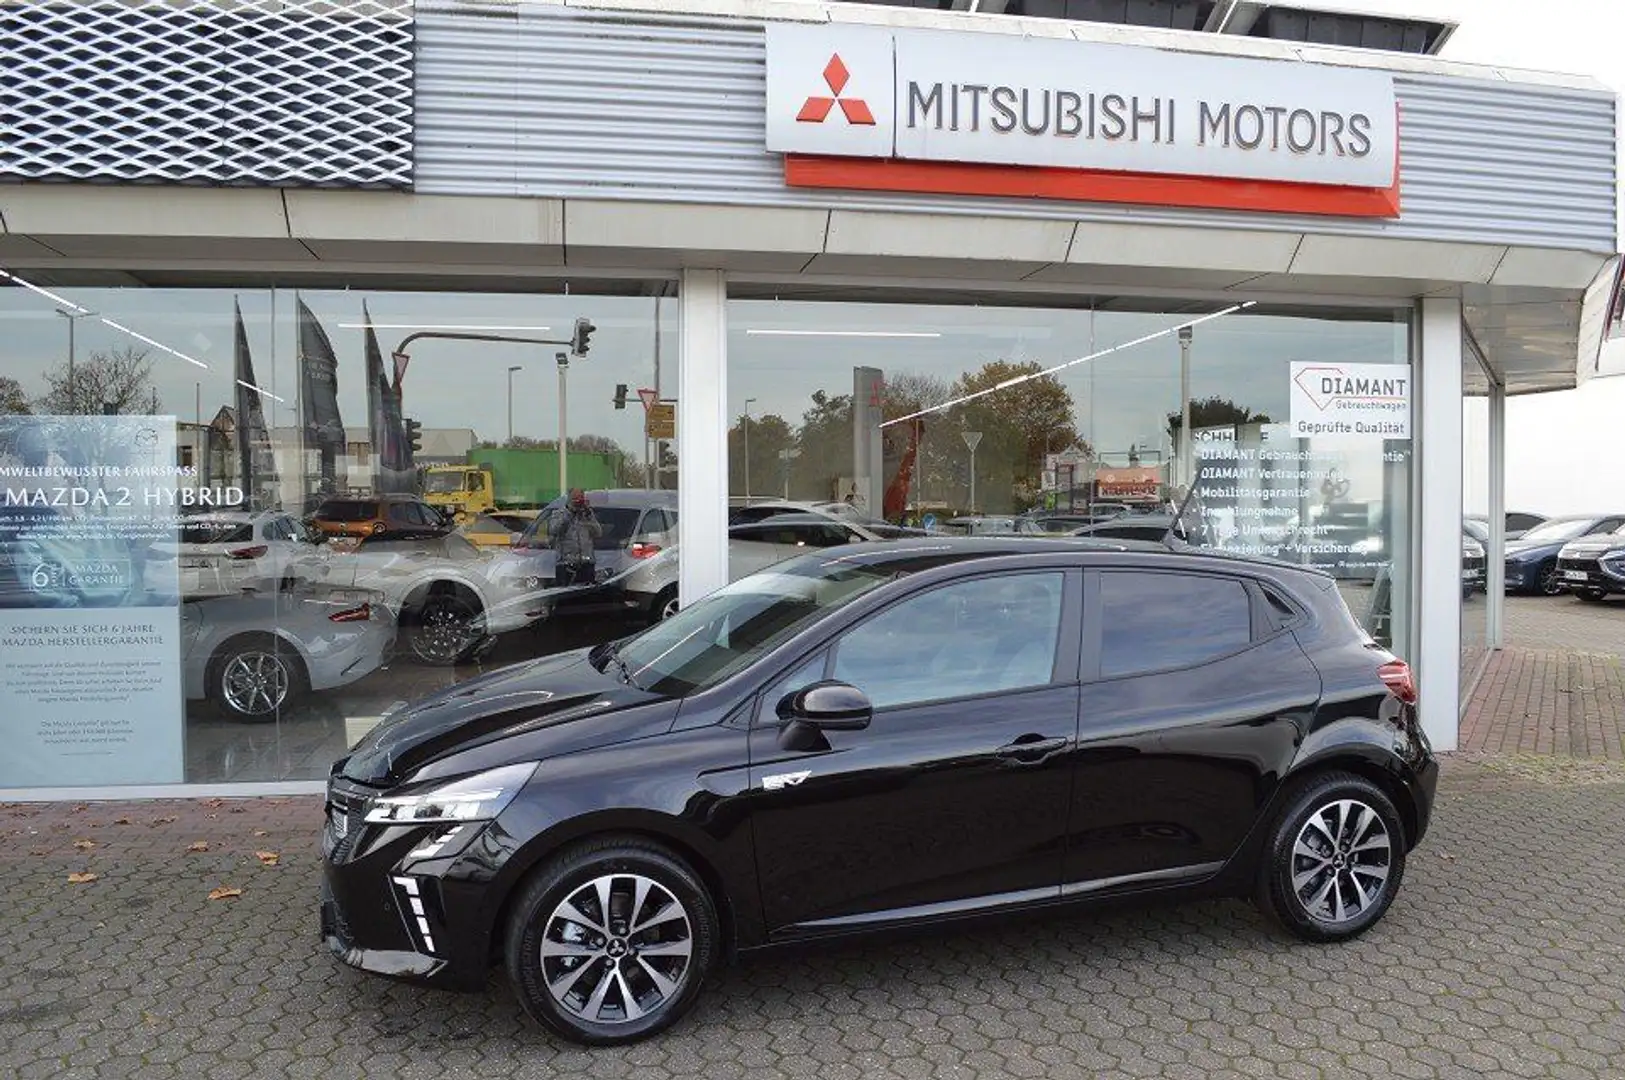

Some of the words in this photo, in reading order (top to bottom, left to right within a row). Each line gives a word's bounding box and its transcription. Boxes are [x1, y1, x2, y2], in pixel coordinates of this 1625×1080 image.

[907, 81, 1175, 145] MITSUBISHI
[1198, 101, 1372, 158] MOTORS
[1321, 377, 1406, 396] DIAMANT
[1335, 400, 1406, 412] Gebrauchtwagen
[1298, 420, 1352, 435] Geprüfte
[1355, 421, 1405, 434] Qualität
[1201, 448, 1255, 460] DIAMANT
[1201, 467, 1255, 479] DIAMANT
[4, 487, 109, 506] MAZDA
[115, 487, 131, 506] 2
[144, 486, 244, 506] HYBRID
[32, 563, 49, 587] 6
[63, 625, 79, 634] SIE
[82, 625, 108, 634] SICH
